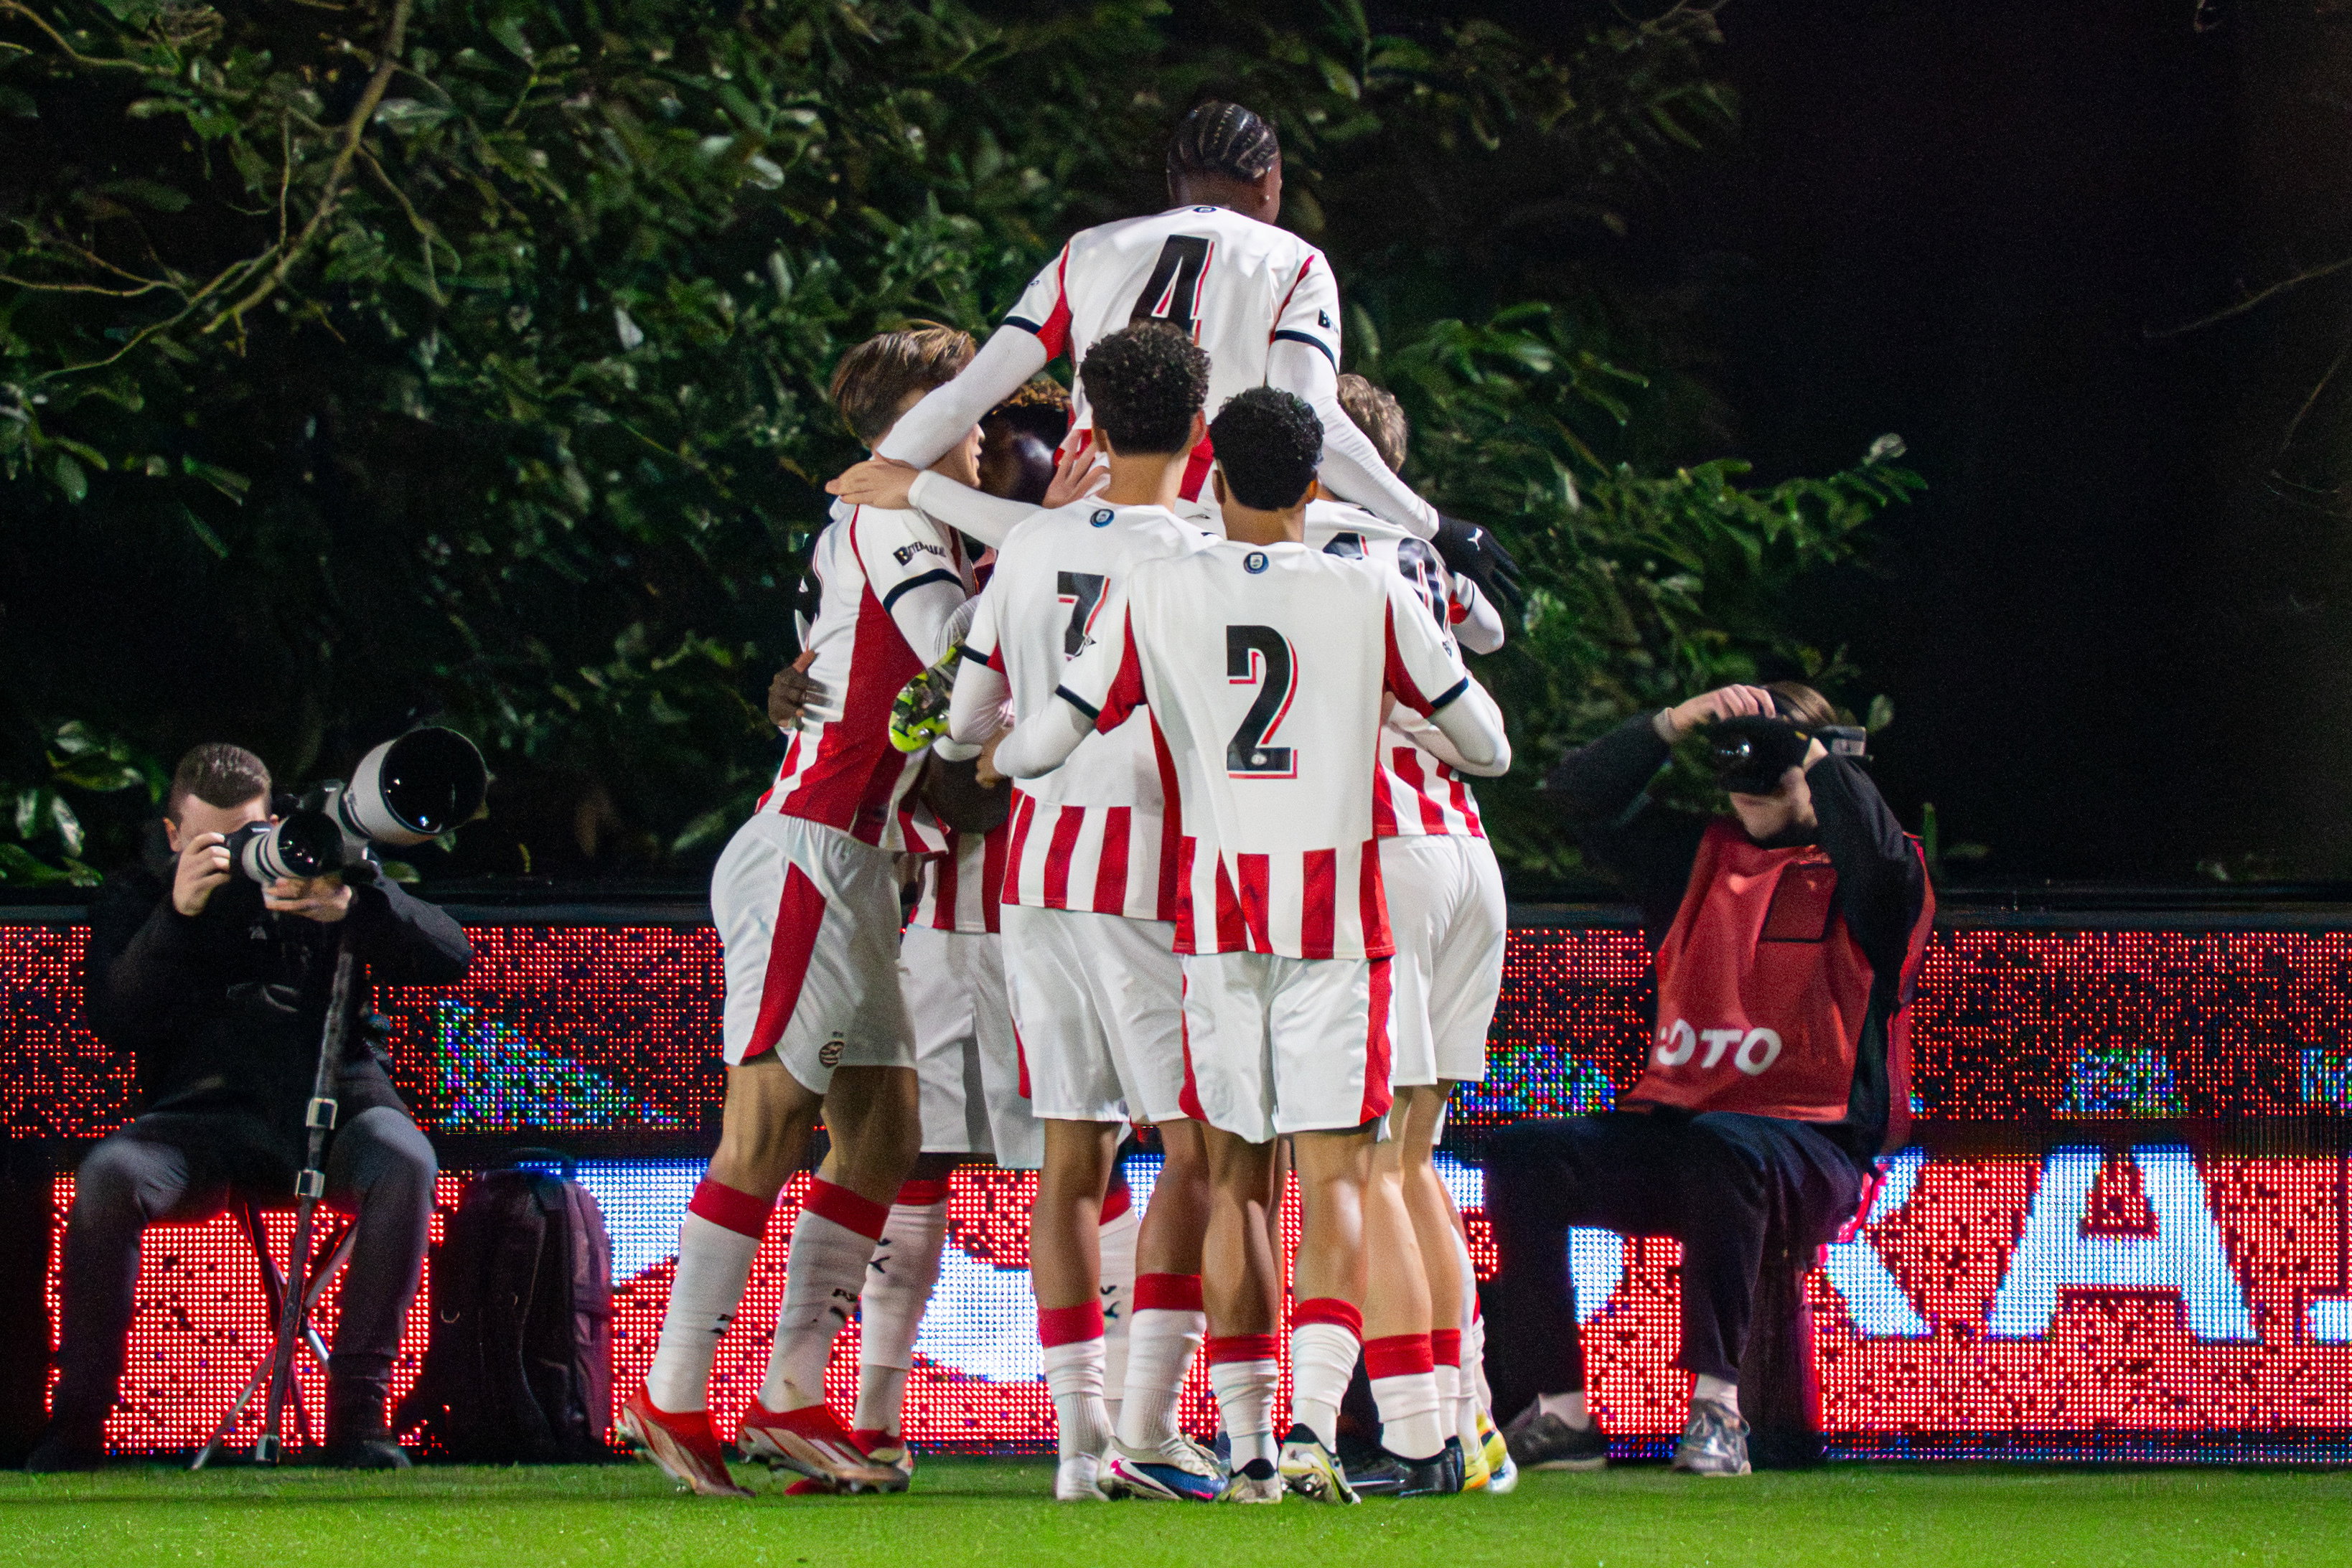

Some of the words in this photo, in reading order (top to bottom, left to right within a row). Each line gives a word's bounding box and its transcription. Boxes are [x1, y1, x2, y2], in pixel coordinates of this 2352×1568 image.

[1129, 234, 1215, 348] 4
[1057, 571, 1110, 661] 7
[1226, 624, 1298, 779] 2
[1656, 1018, 1783, 1076] OTO
